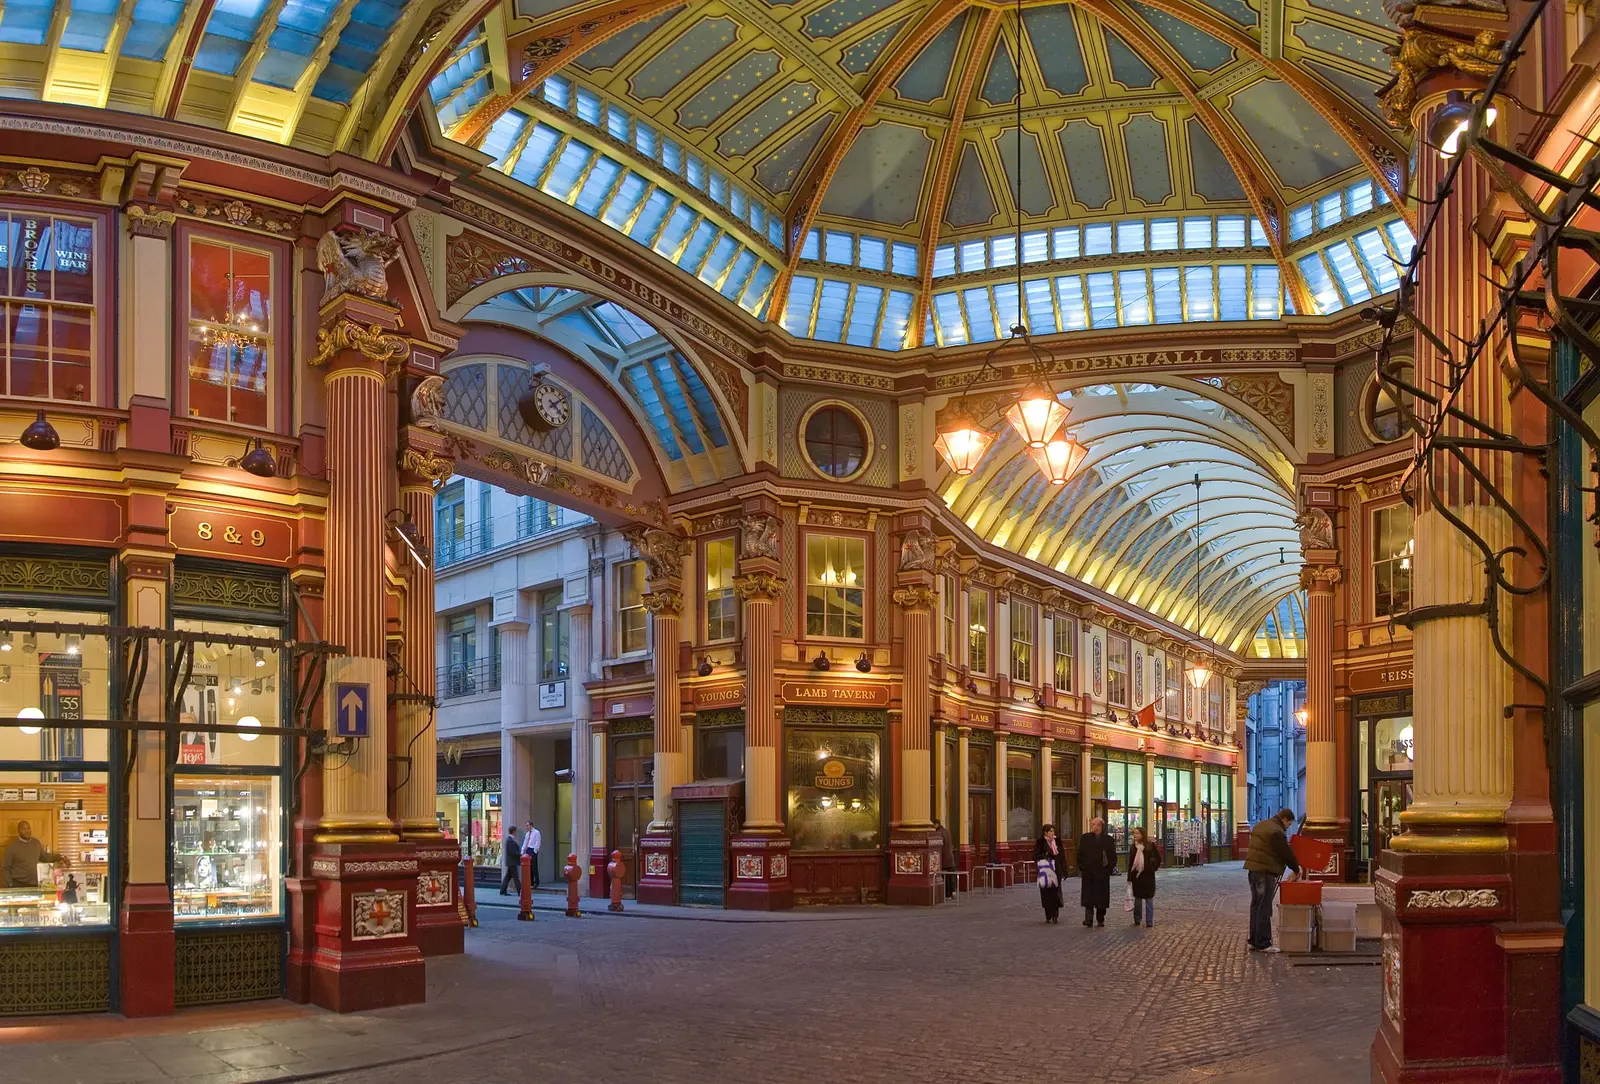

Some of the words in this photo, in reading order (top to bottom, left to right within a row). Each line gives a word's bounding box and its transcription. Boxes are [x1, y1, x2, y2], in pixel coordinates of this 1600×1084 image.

[24, 219, 38, 293] BROKERS
[55, 249, 92, 261] WINE
[60, 258, 86, 269] BAR
[629, 278, 672, 315] 1881
[1011, 350, 1213, 379] LEADENHALL
[197, 522, 213, 540] 8
[223, 526, 243, 544] &
[251, 529, 265, 547] 9
[700, 689, 740, 702] YOUNGS
[796, 688, 828, 698] LAMB
[832, 689, 876, 700] TAVERN
[970, 713, 990, 723] LAMB
[1012, 719, 1033, 729] TAVERN
